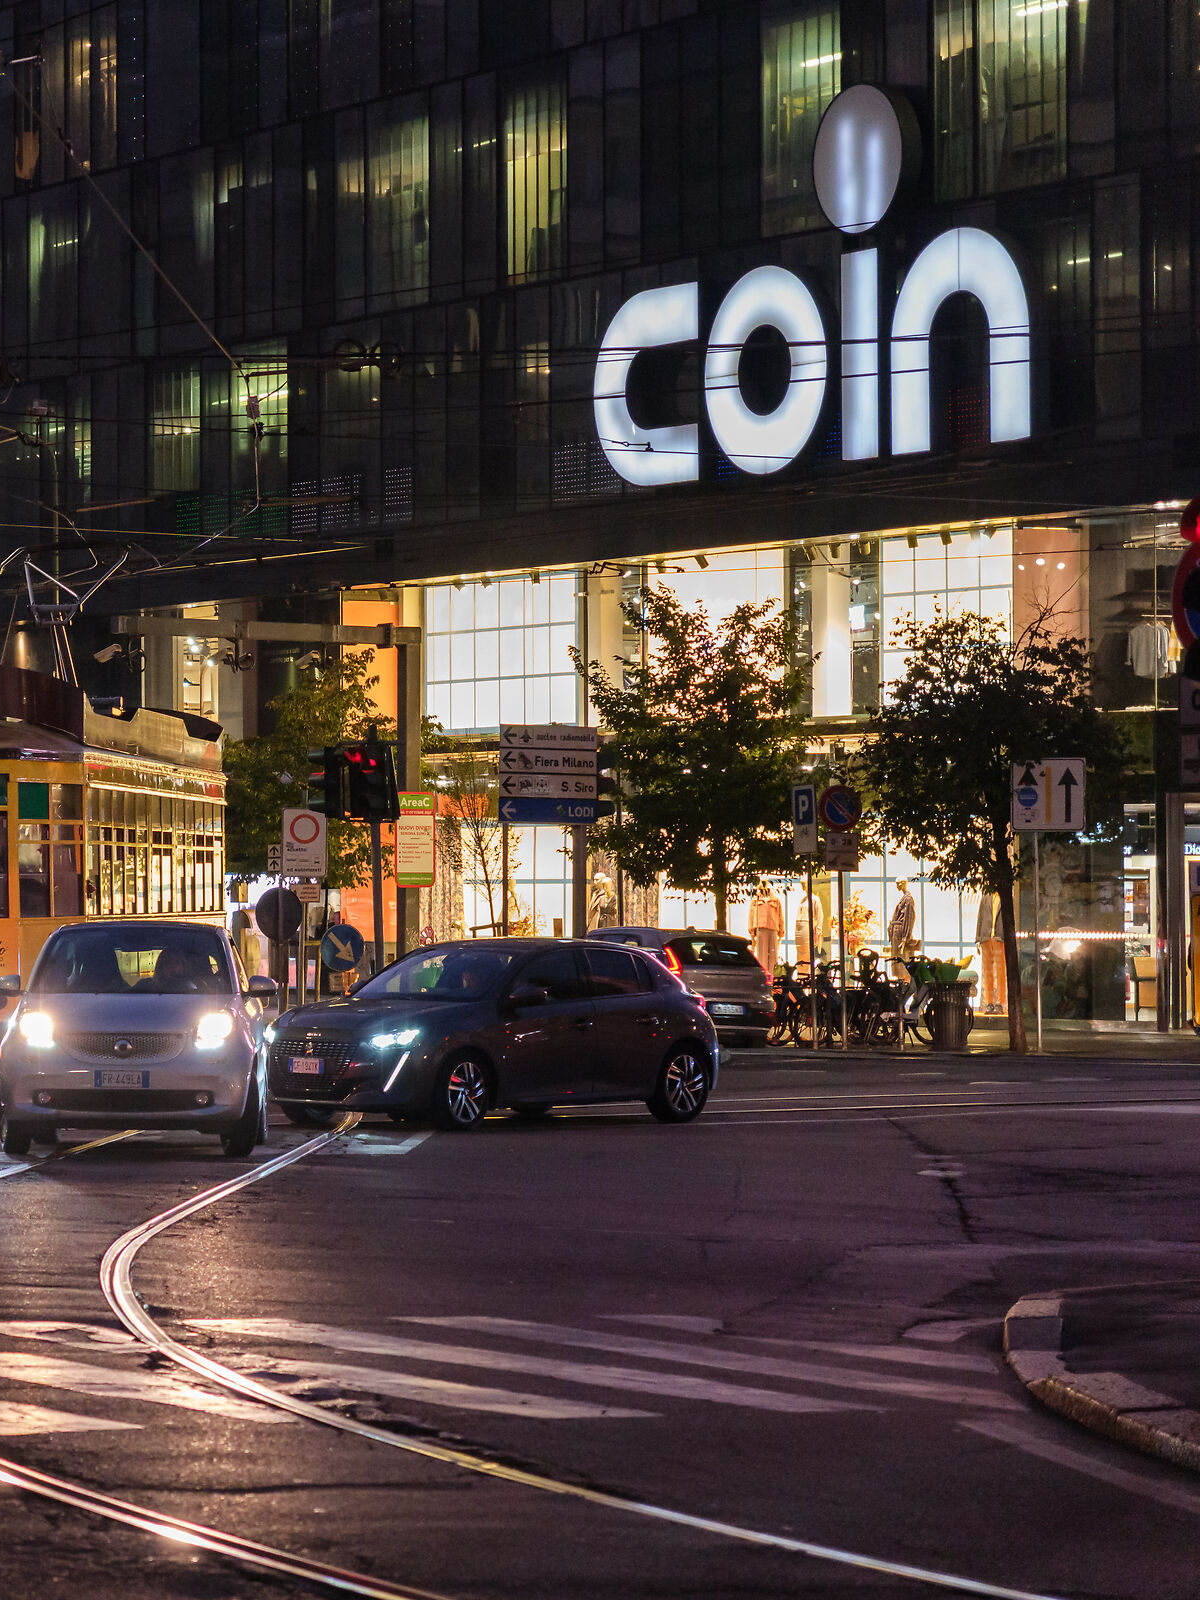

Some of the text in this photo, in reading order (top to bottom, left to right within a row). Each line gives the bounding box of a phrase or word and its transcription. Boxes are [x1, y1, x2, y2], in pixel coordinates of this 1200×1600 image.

[592, 83, 1033, 487] coin
[535, 756, 594, 768] Fiera Milano
[561, 781, 594, 793] S. Siro
[568, 806, 595, 817] LODI
[798, 794, 809, 820] P
